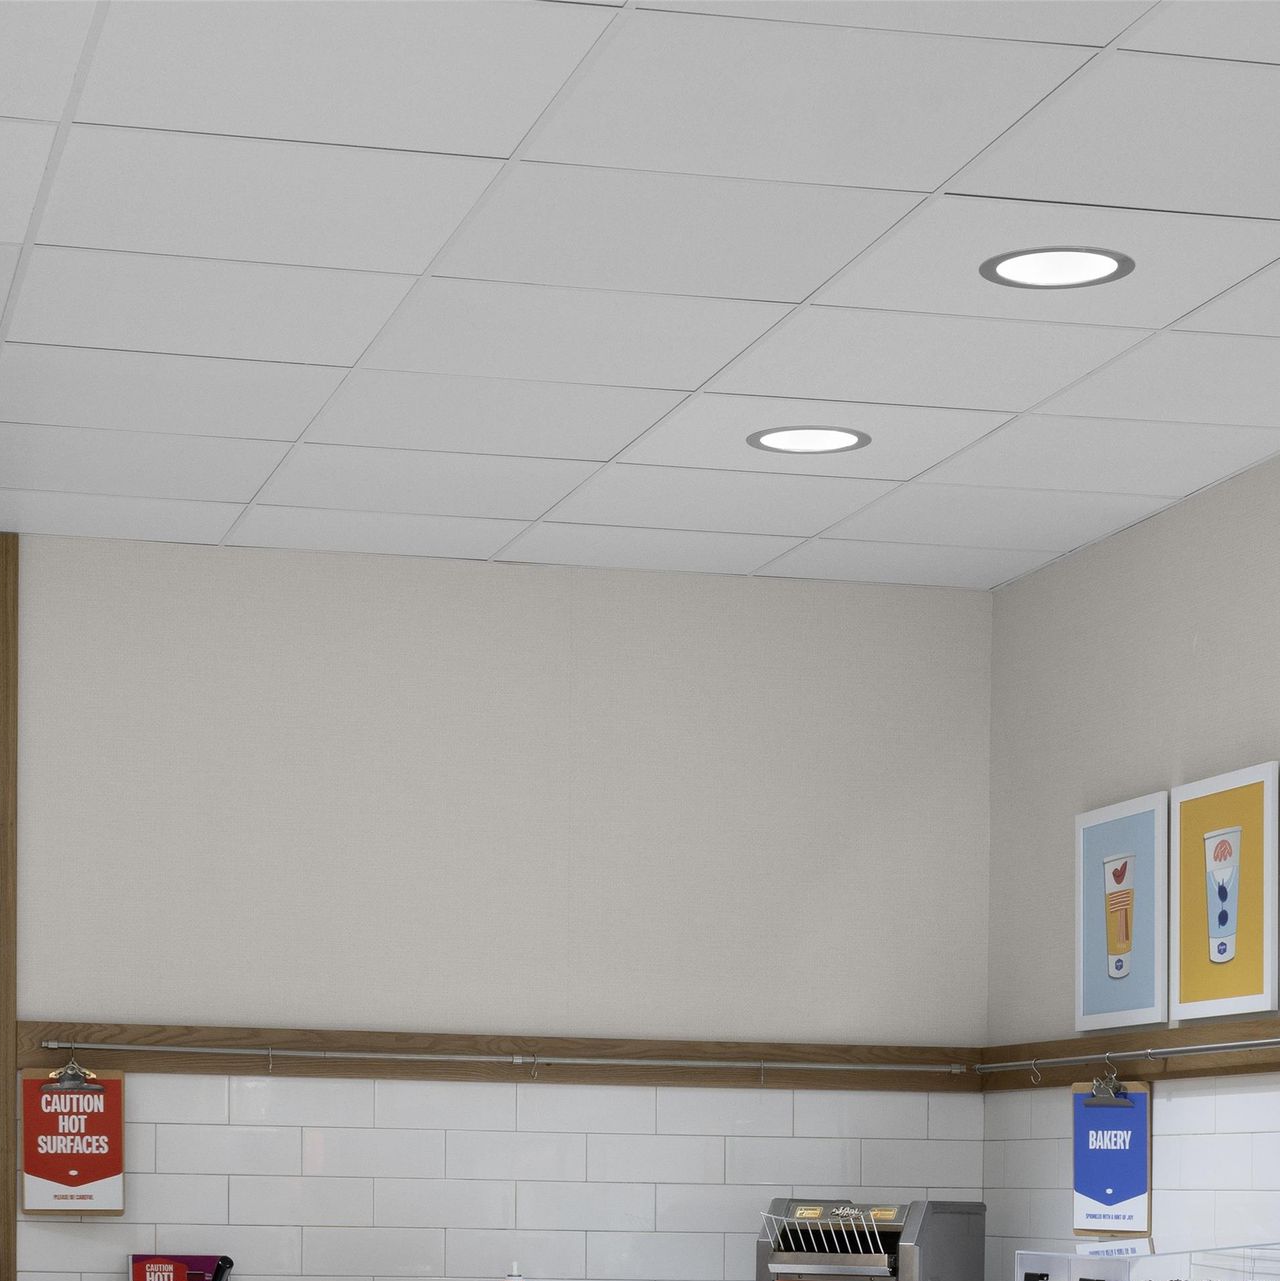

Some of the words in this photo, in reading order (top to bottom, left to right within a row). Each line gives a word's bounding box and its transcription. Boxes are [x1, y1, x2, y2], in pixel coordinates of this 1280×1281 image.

[40, 1094, 105, 1113] CAUTION
[58, 1115, 87, 1134] HOT
[37, 1135, 109, 1155] SURFACES
[1088, 1130, 1132, 1150] BAKERY
[145, 1263, 174, 1272] CAUTION
